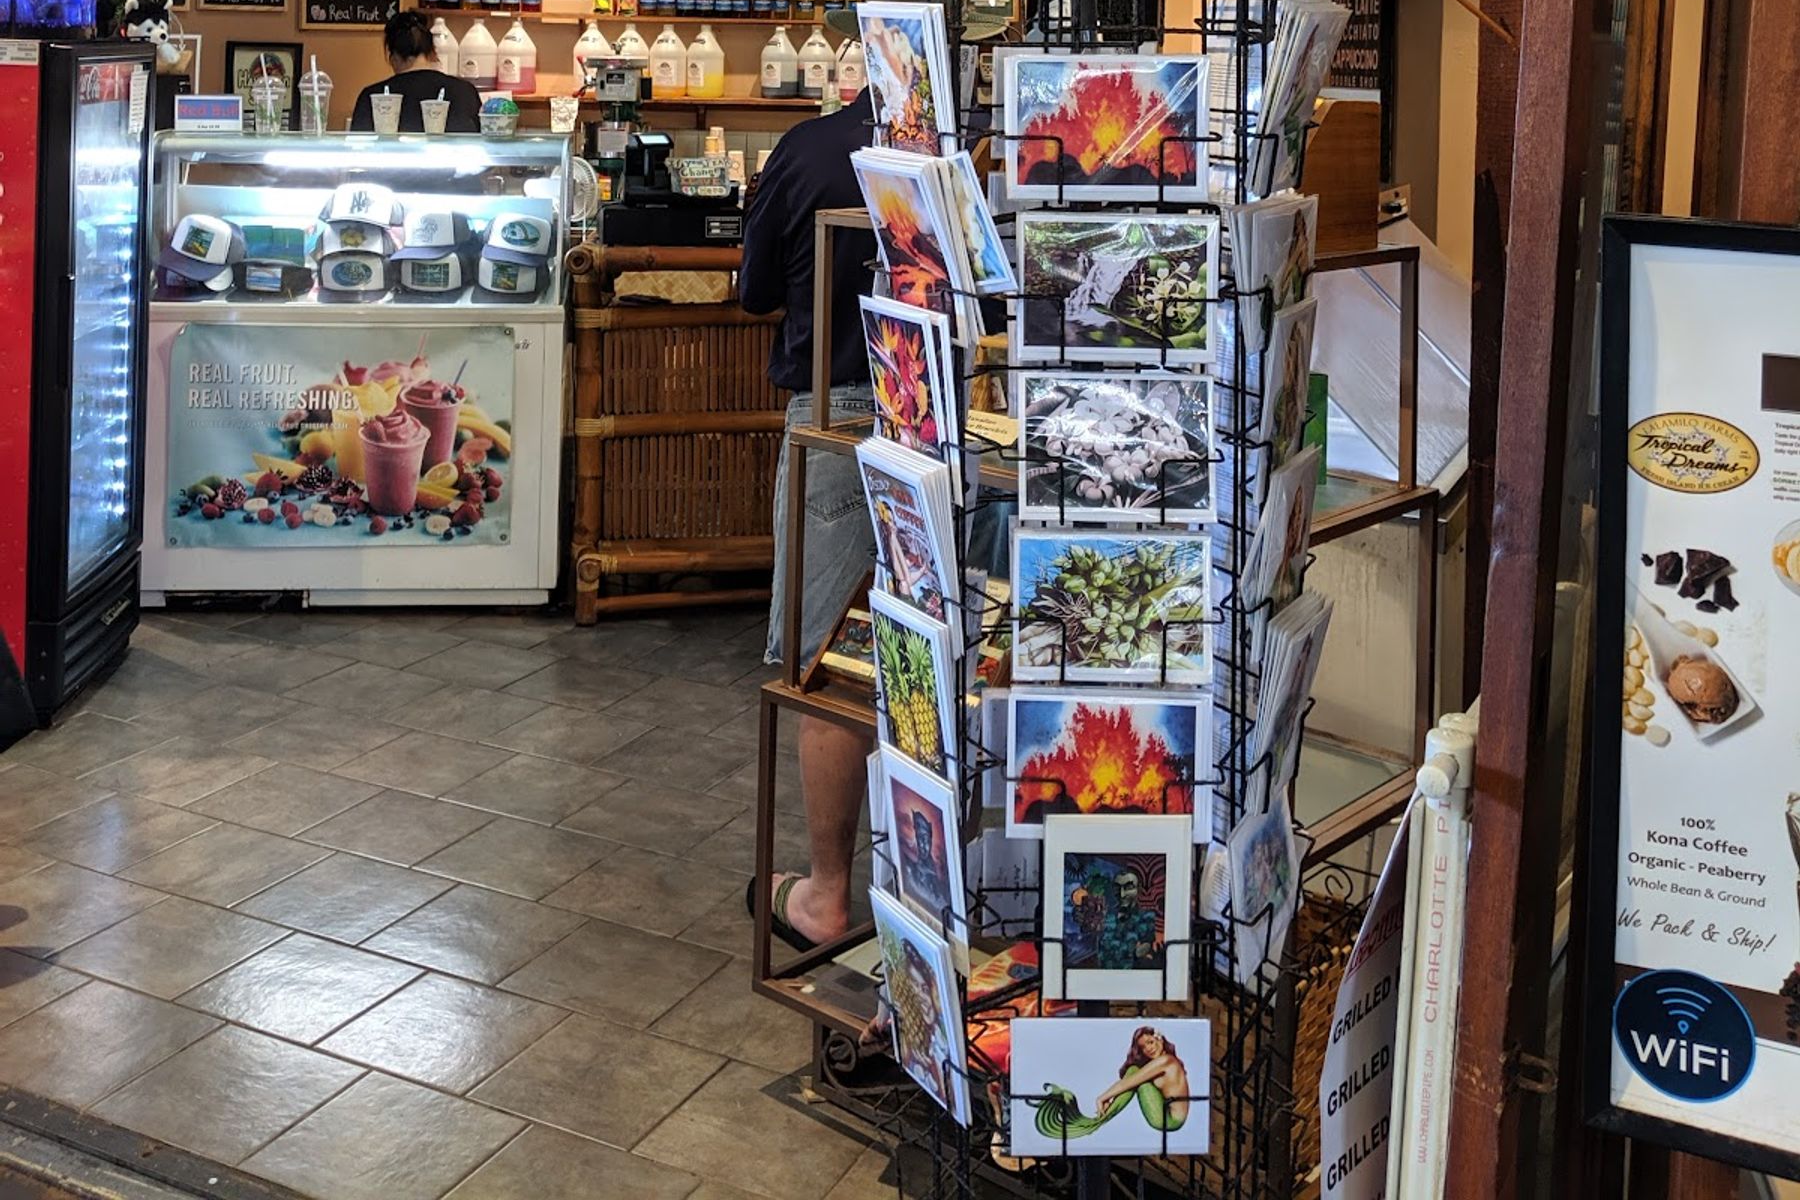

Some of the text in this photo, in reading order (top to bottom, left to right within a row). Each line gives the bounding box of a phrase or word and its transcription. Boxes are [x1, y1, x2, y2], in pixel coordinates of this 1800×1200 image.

[179, 101, 239, 117] Red Bull
[188, 362, 234, 385] REAL
[188, 388, 234, 409] REAL
[1633, 433, 1715, 455] Tropical
[1661, 451, 1748, 472] Dreams
[1680, 816, 1716, 831] 100%
[1646, 830, 1748, 857] Kona Coffee
[1628, 851, 1686, 872] Organic
[1698, 861, 1766, 886] Peaberry
[1627, 876, 1766, 908] Whole Bean & Ground
[1424, 854, 1448, 1024] CHARLOTTE
[1617, 908, 1778, 956] We Pack & Ship!
[1333, 975, 1391, 1045] GRILLED
[1630, 1029, 1731, 1083] WiFi
[1327, 1045, 1390, 1117] GRILLED
[1327, 1116, 1390, 1191] GRILLED
